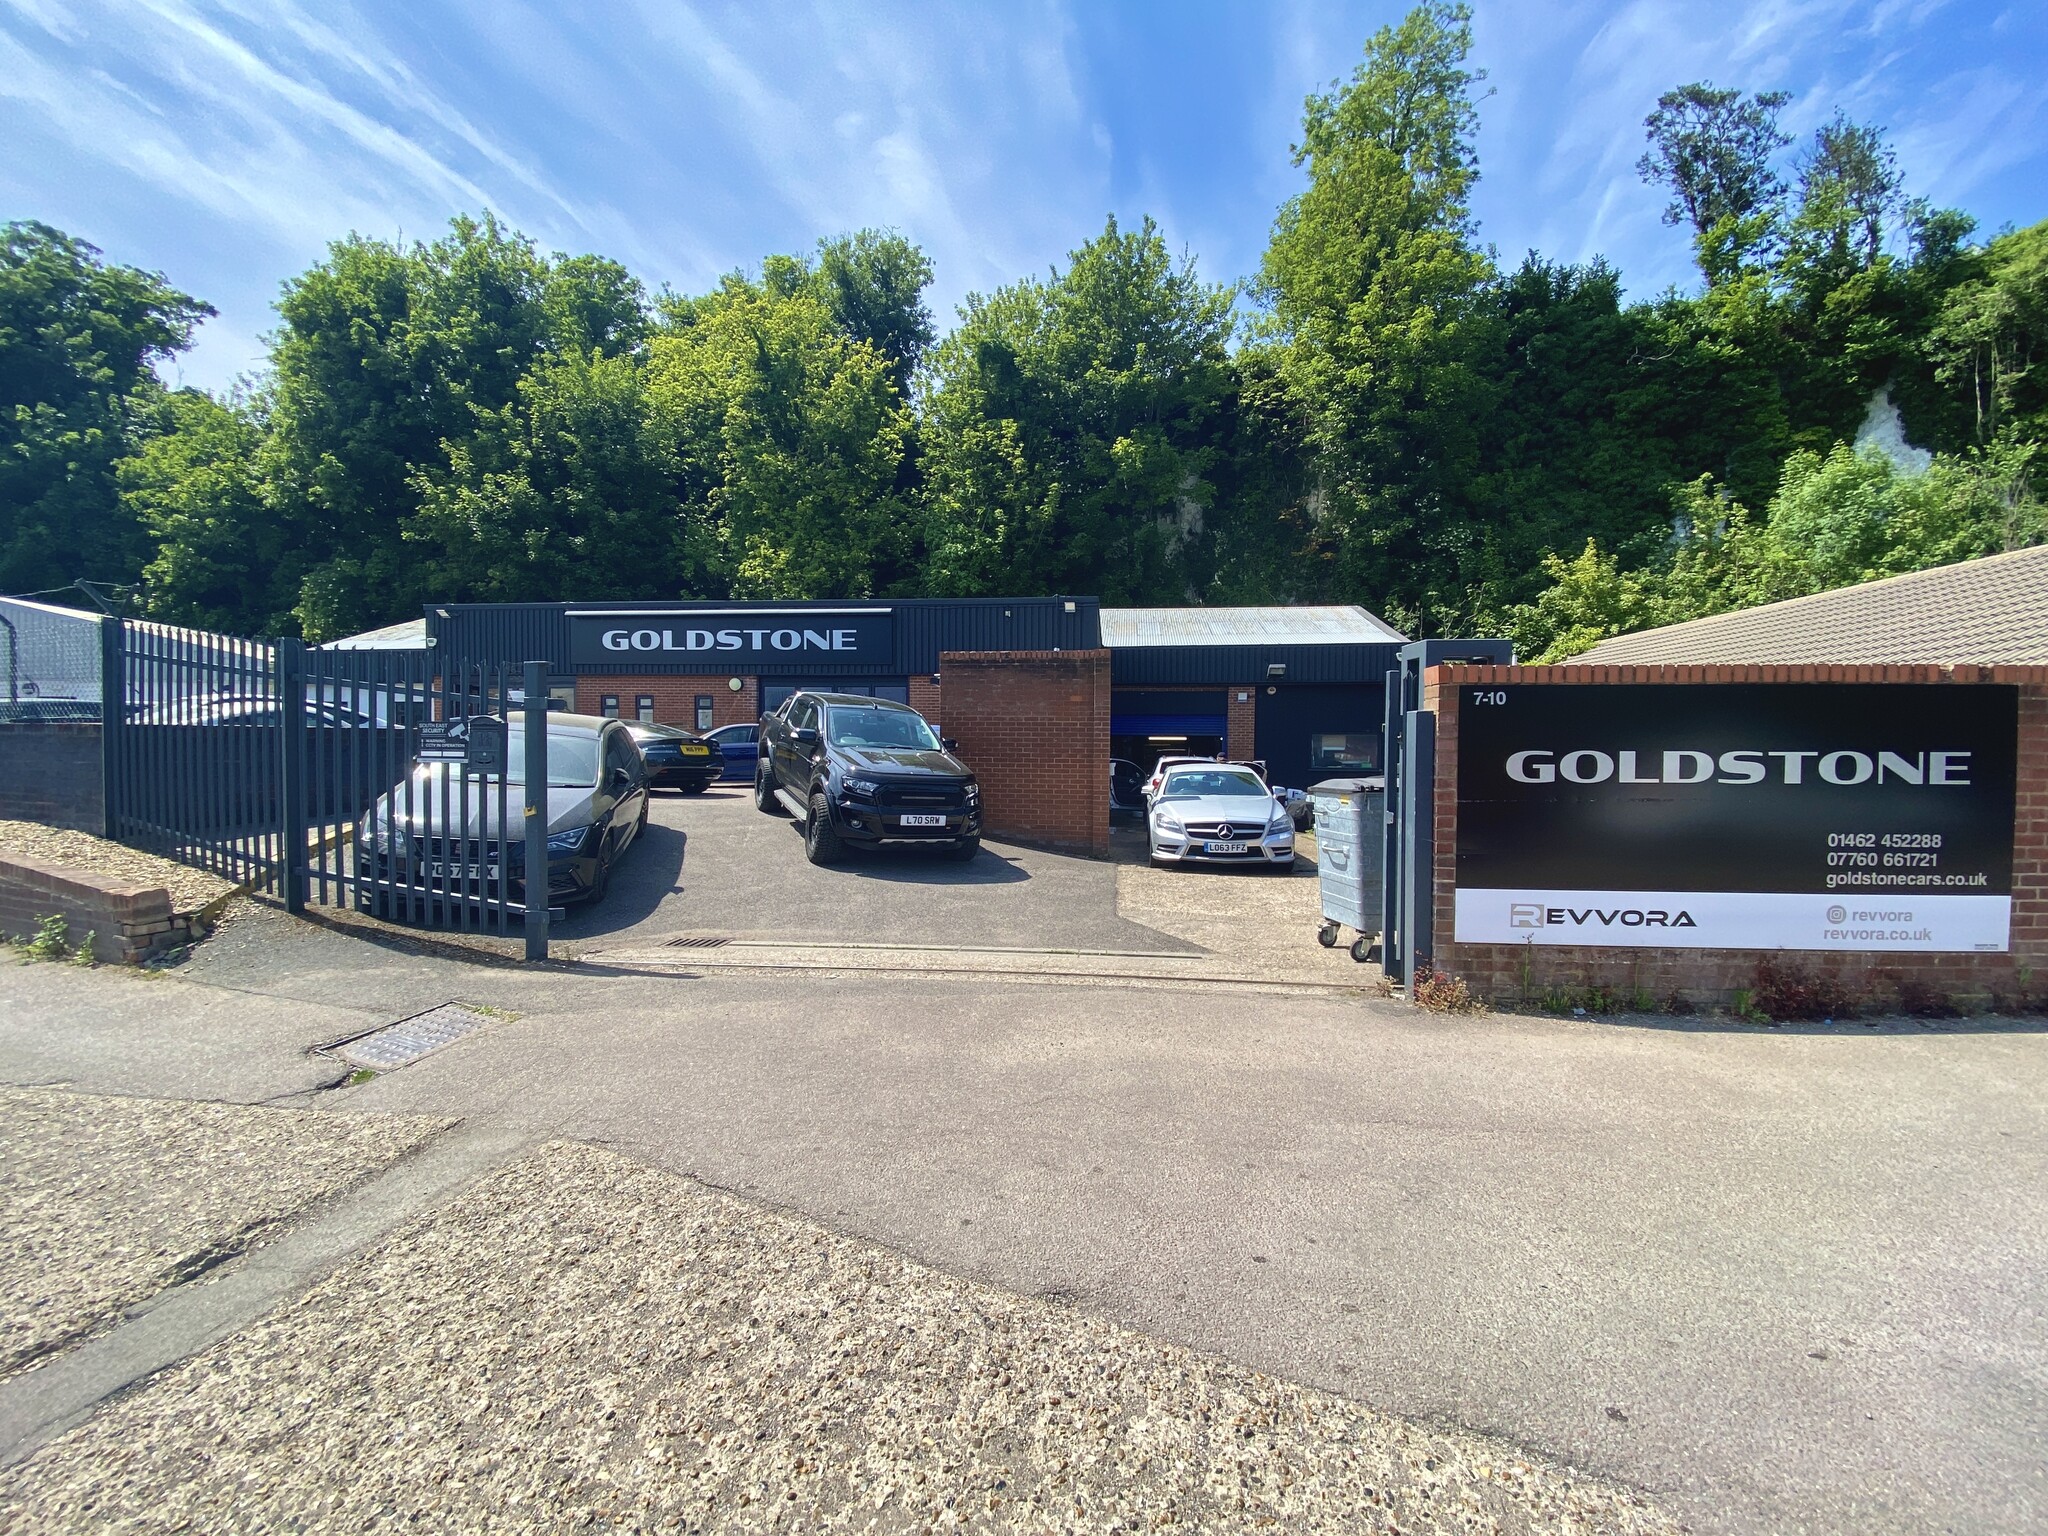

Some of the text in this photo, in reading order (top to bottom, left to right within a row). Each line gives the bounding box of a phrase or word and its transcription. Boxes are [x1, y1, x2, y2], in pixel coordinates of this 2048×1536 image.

[601, 629, 858, 651] GOLDSTONE
[1473, 691, 1507, 705] 7-10
[1505, 750, 1972, 785] GOLDSTONE
[906, 816, 940, 825] L70 SRW
[1827, 833, 1942, 848] 01462 452288
[1826, 852, 1937, 867] 07760 661721
[1826, 872, 1987, 888] goldstonecars.co.uk
[1511, 903, 1698, 928] REVVORA
[1852, 910, 1913, 922] revvora
[1823, 928, 1932, 941] revvora.co.uk
